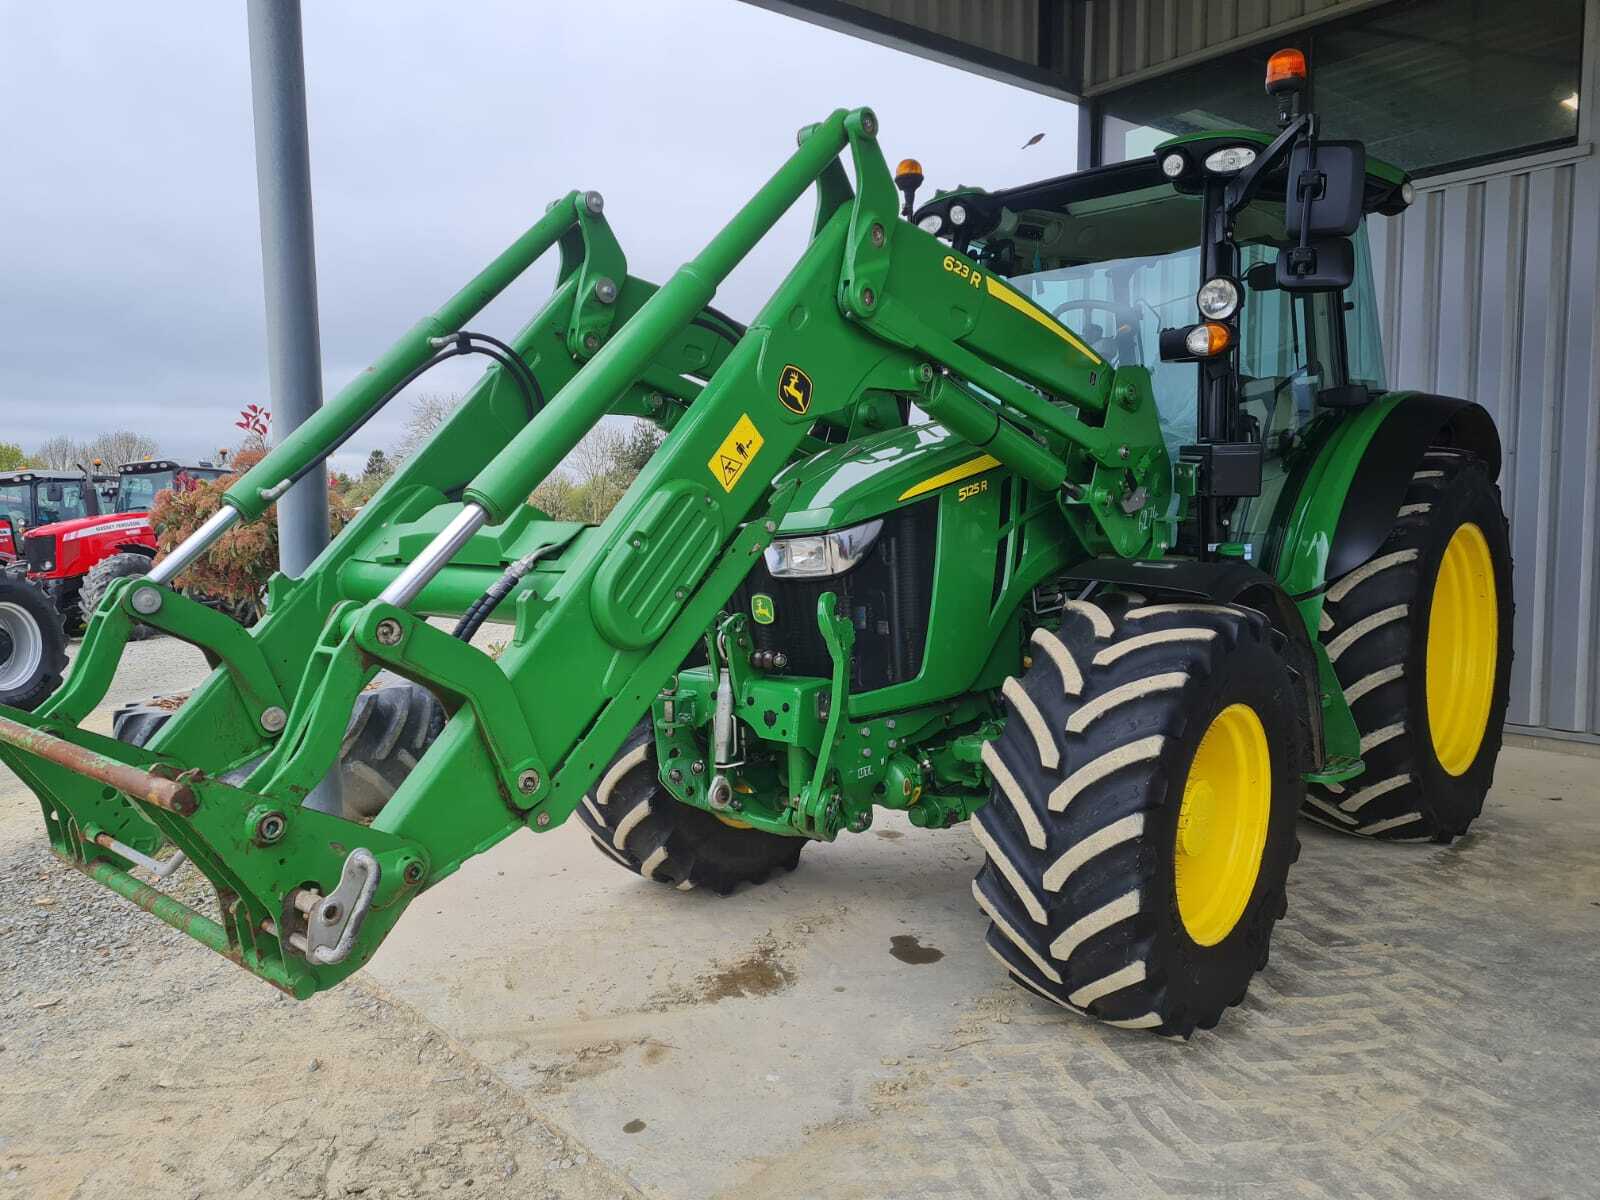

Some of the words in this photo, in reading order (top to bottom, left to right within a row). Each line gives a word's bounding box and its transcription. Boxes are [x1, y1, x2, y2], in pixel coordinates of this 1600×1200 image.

[943, 255, 970, 278] 623
[970, 271, 982, 289] R
[959, 482, 980, 501] 5125
[981, 480, 988, 491] R
